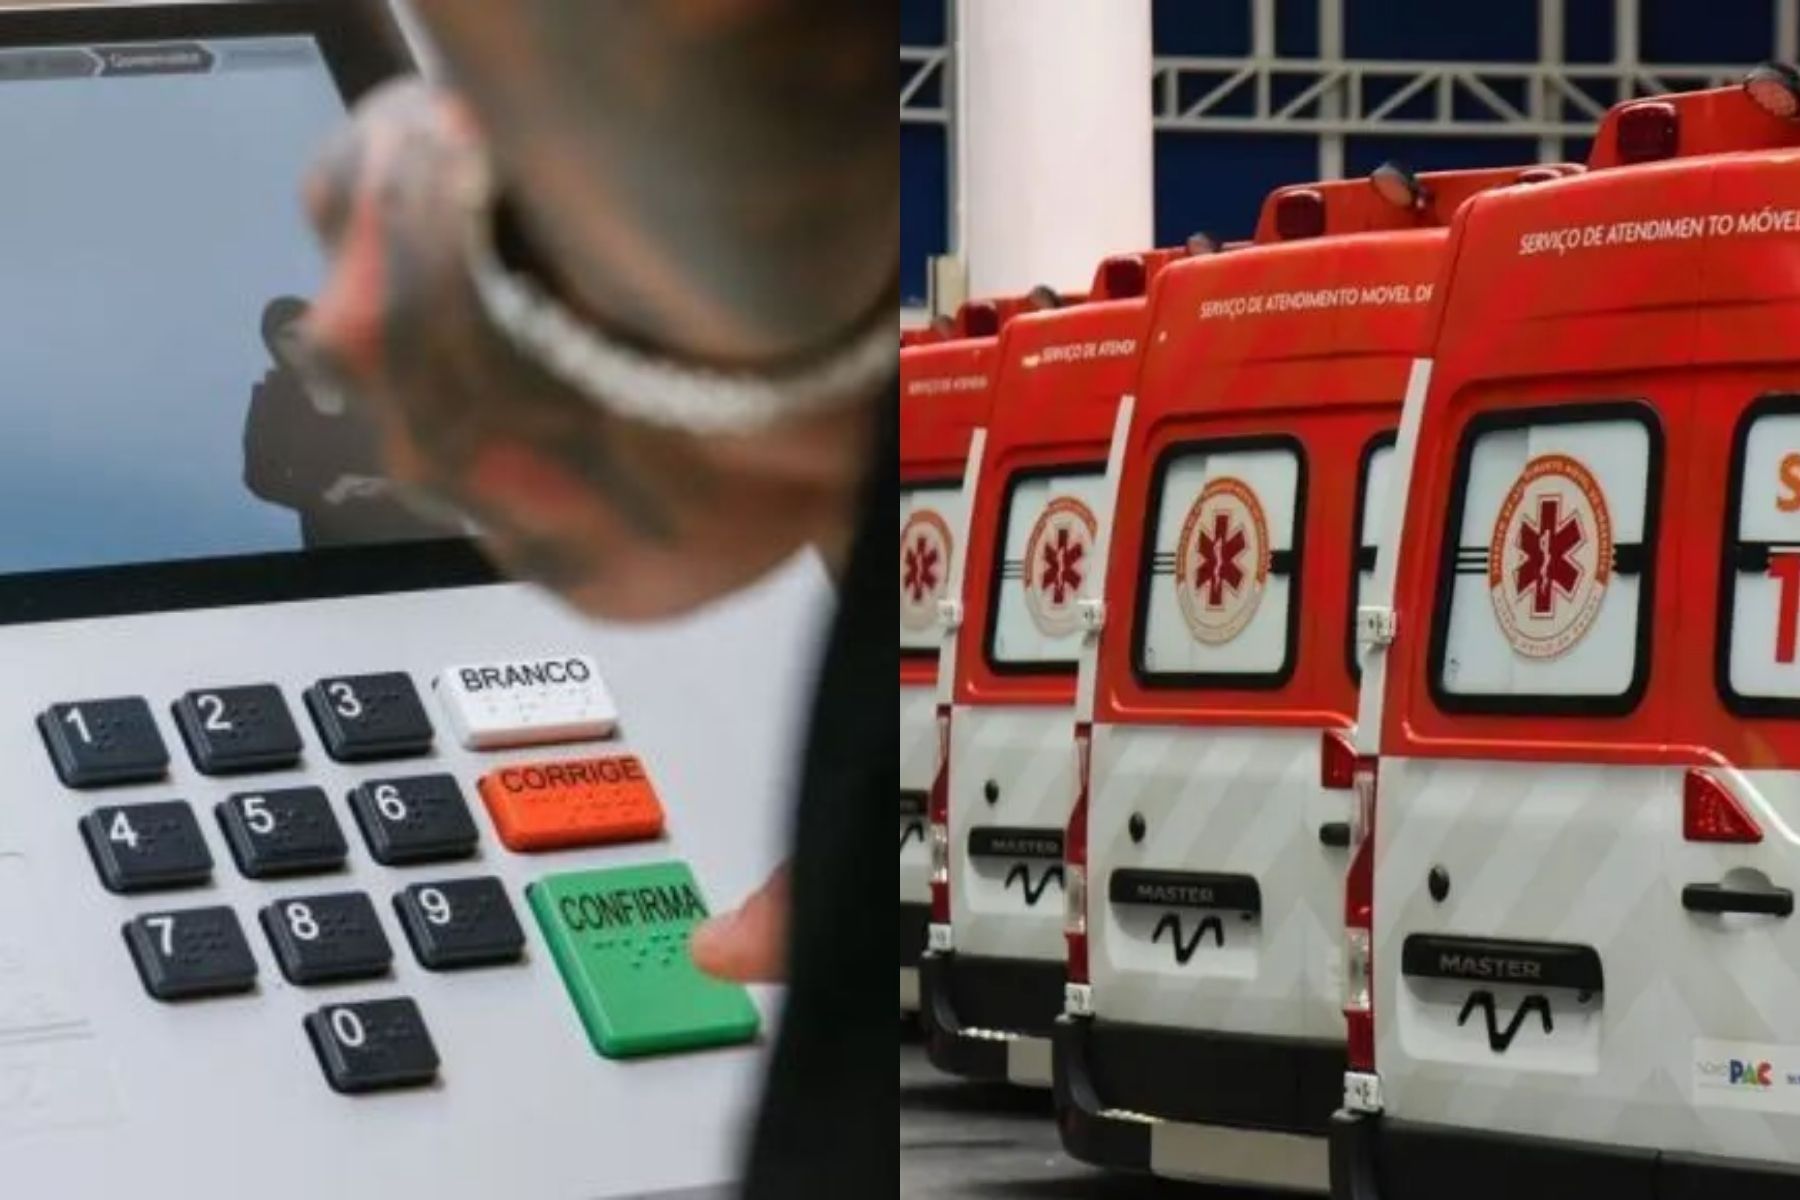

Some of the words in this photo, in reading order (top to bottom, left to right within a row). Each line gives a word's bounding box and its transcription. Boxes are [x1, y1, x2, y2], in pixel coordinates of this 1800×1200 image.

[1518, 228, 1580, 256] SERVIÇO
[1583, 225, 1604, 247] DE
[1707, 213, 1734, 236] TO
[1200, 297, 1246, 321] SERVIÇO
[1248, 295, 1264, 314] DE
[1266, 288, 1360, 311] ATENDIMENTO
[460, 657, 590, 692] BRANCO
[198, 695, 231, 730] 2
[328, 682, 362, 717] 3
[66, 708, 92, 743] 1
[501, 757, 646, 793] CORRIGE
[243, 797, 275, 833] 5
[375, 785, 406, 820] 6
[110, 812, 138, 848] 4
[419, 888, 450, 924] 9
[560, 883, 708, 932] CONFIRMA
[1136, 884, 1215, 903] MASTER
[147, 917, 175, 956] 7
[286, 902, 319, 939] 8
[1438, 953, 1542, 979] MASTER
[332, 1009, 366, 1047] 0
[1729, 1059, 1773, 1087] PAC
